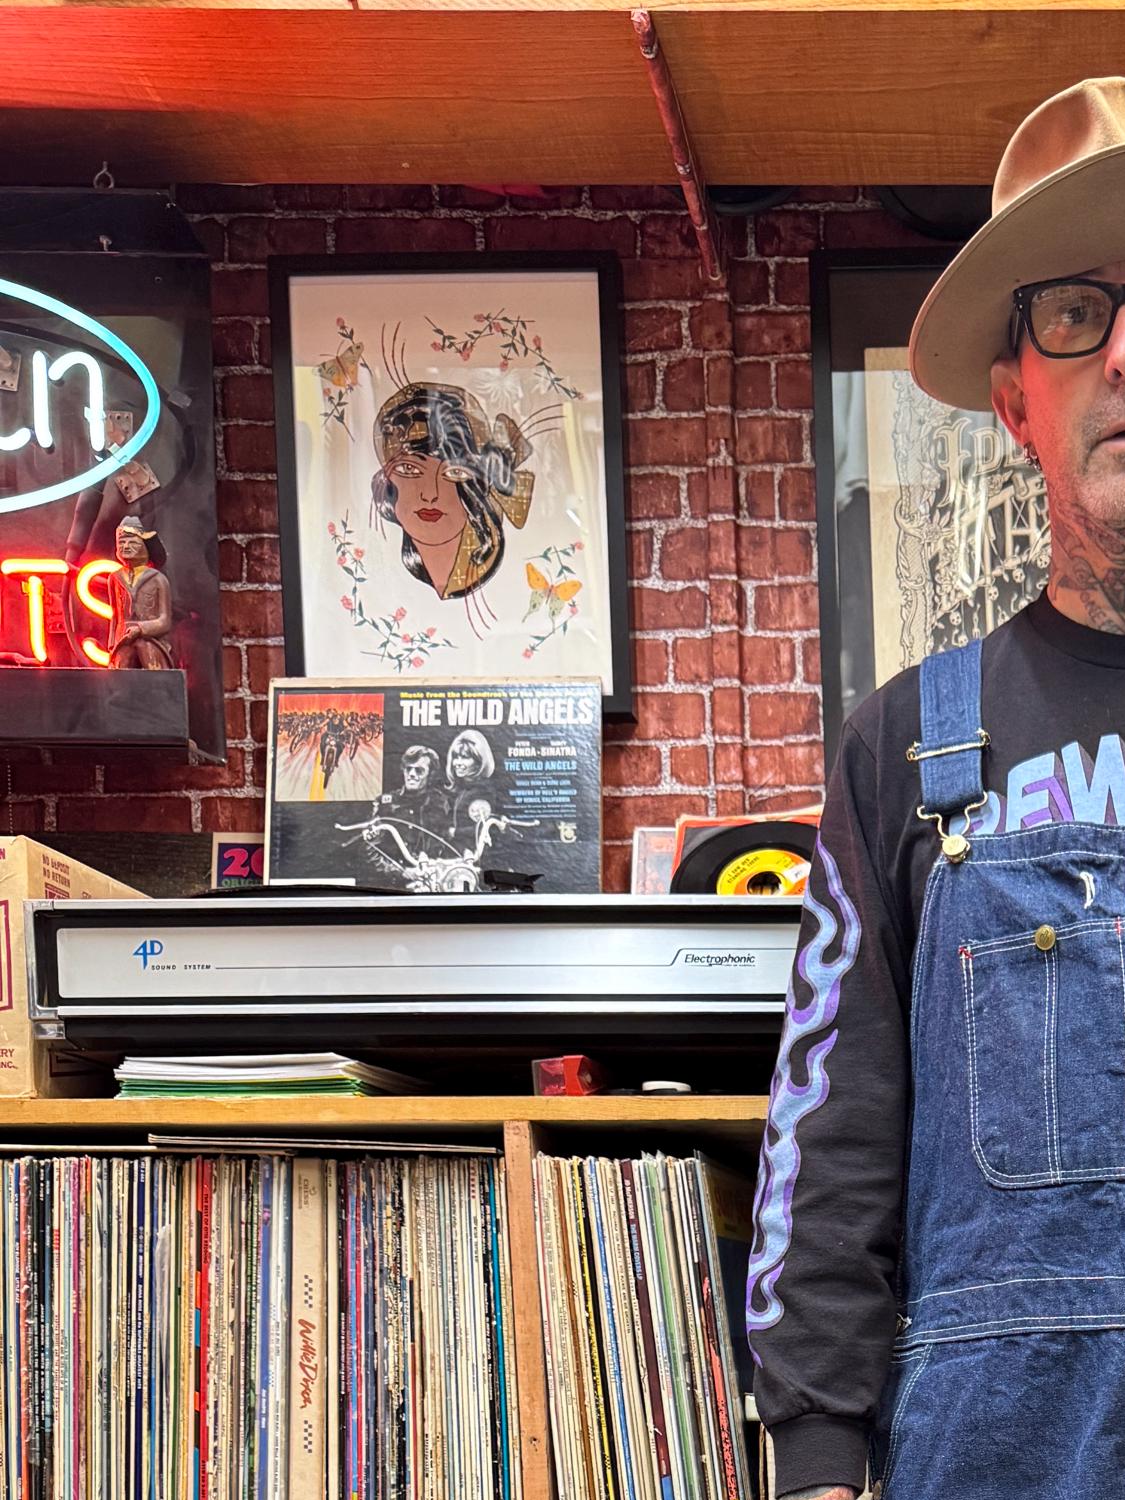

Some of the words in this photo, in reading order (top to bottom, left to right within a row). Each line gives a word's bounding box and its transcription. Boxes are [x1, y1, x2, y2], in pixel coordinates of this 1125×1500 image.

[400, 699, 442, 727] THE
[446, 699, 503, 727] WILD
[508, 698, 594, 726] ANGELS
[508, 747, 537, 757] FONDA
[540, 746, 577, 757] SINATRA
[52, 871, 71, 888] RETURN
[684, 953, 756, 966] Electrophonic
[626, 1187, 635, 1219] McPHERSON
[298, 1319, 317, 1362] Willie
[300, 1363, 318, 1410] Dixon
